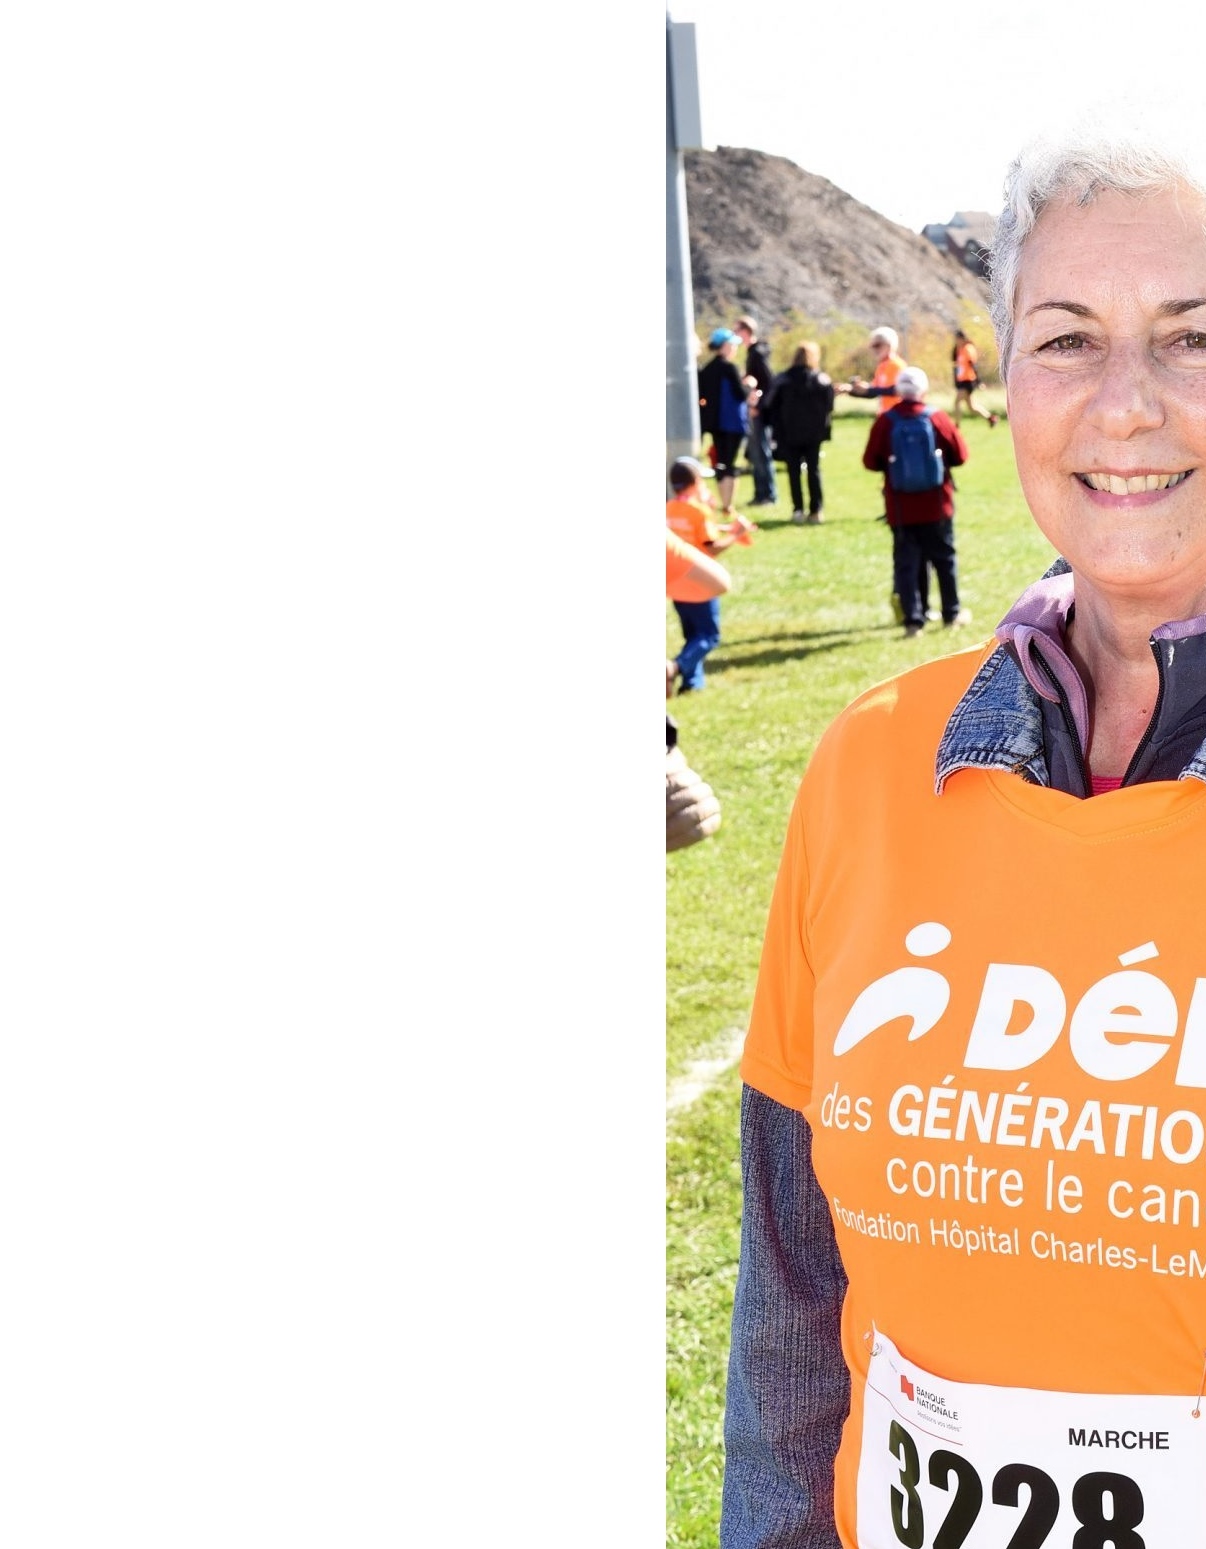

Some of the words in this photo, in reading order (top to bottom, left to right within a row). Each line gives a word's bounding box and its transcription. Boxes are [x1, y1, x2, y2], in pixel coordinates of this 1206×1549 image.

[820, 1081, 873, 1132] des
[886, 1154, 1024, 1208] contre
[1046, 1159, 1083, 1214] le
[833, 1197, 920, 1244] Fondation
[929, 1219, 1019, 1256] Hôpital
[916, 1386, 946, 1406] BANQUE
[916, 1396, 959, 1420] NATIONALE
[1068, 1427, 1170, 1450] MARCHE
[888, 1419, 1147, 1549] 3228
